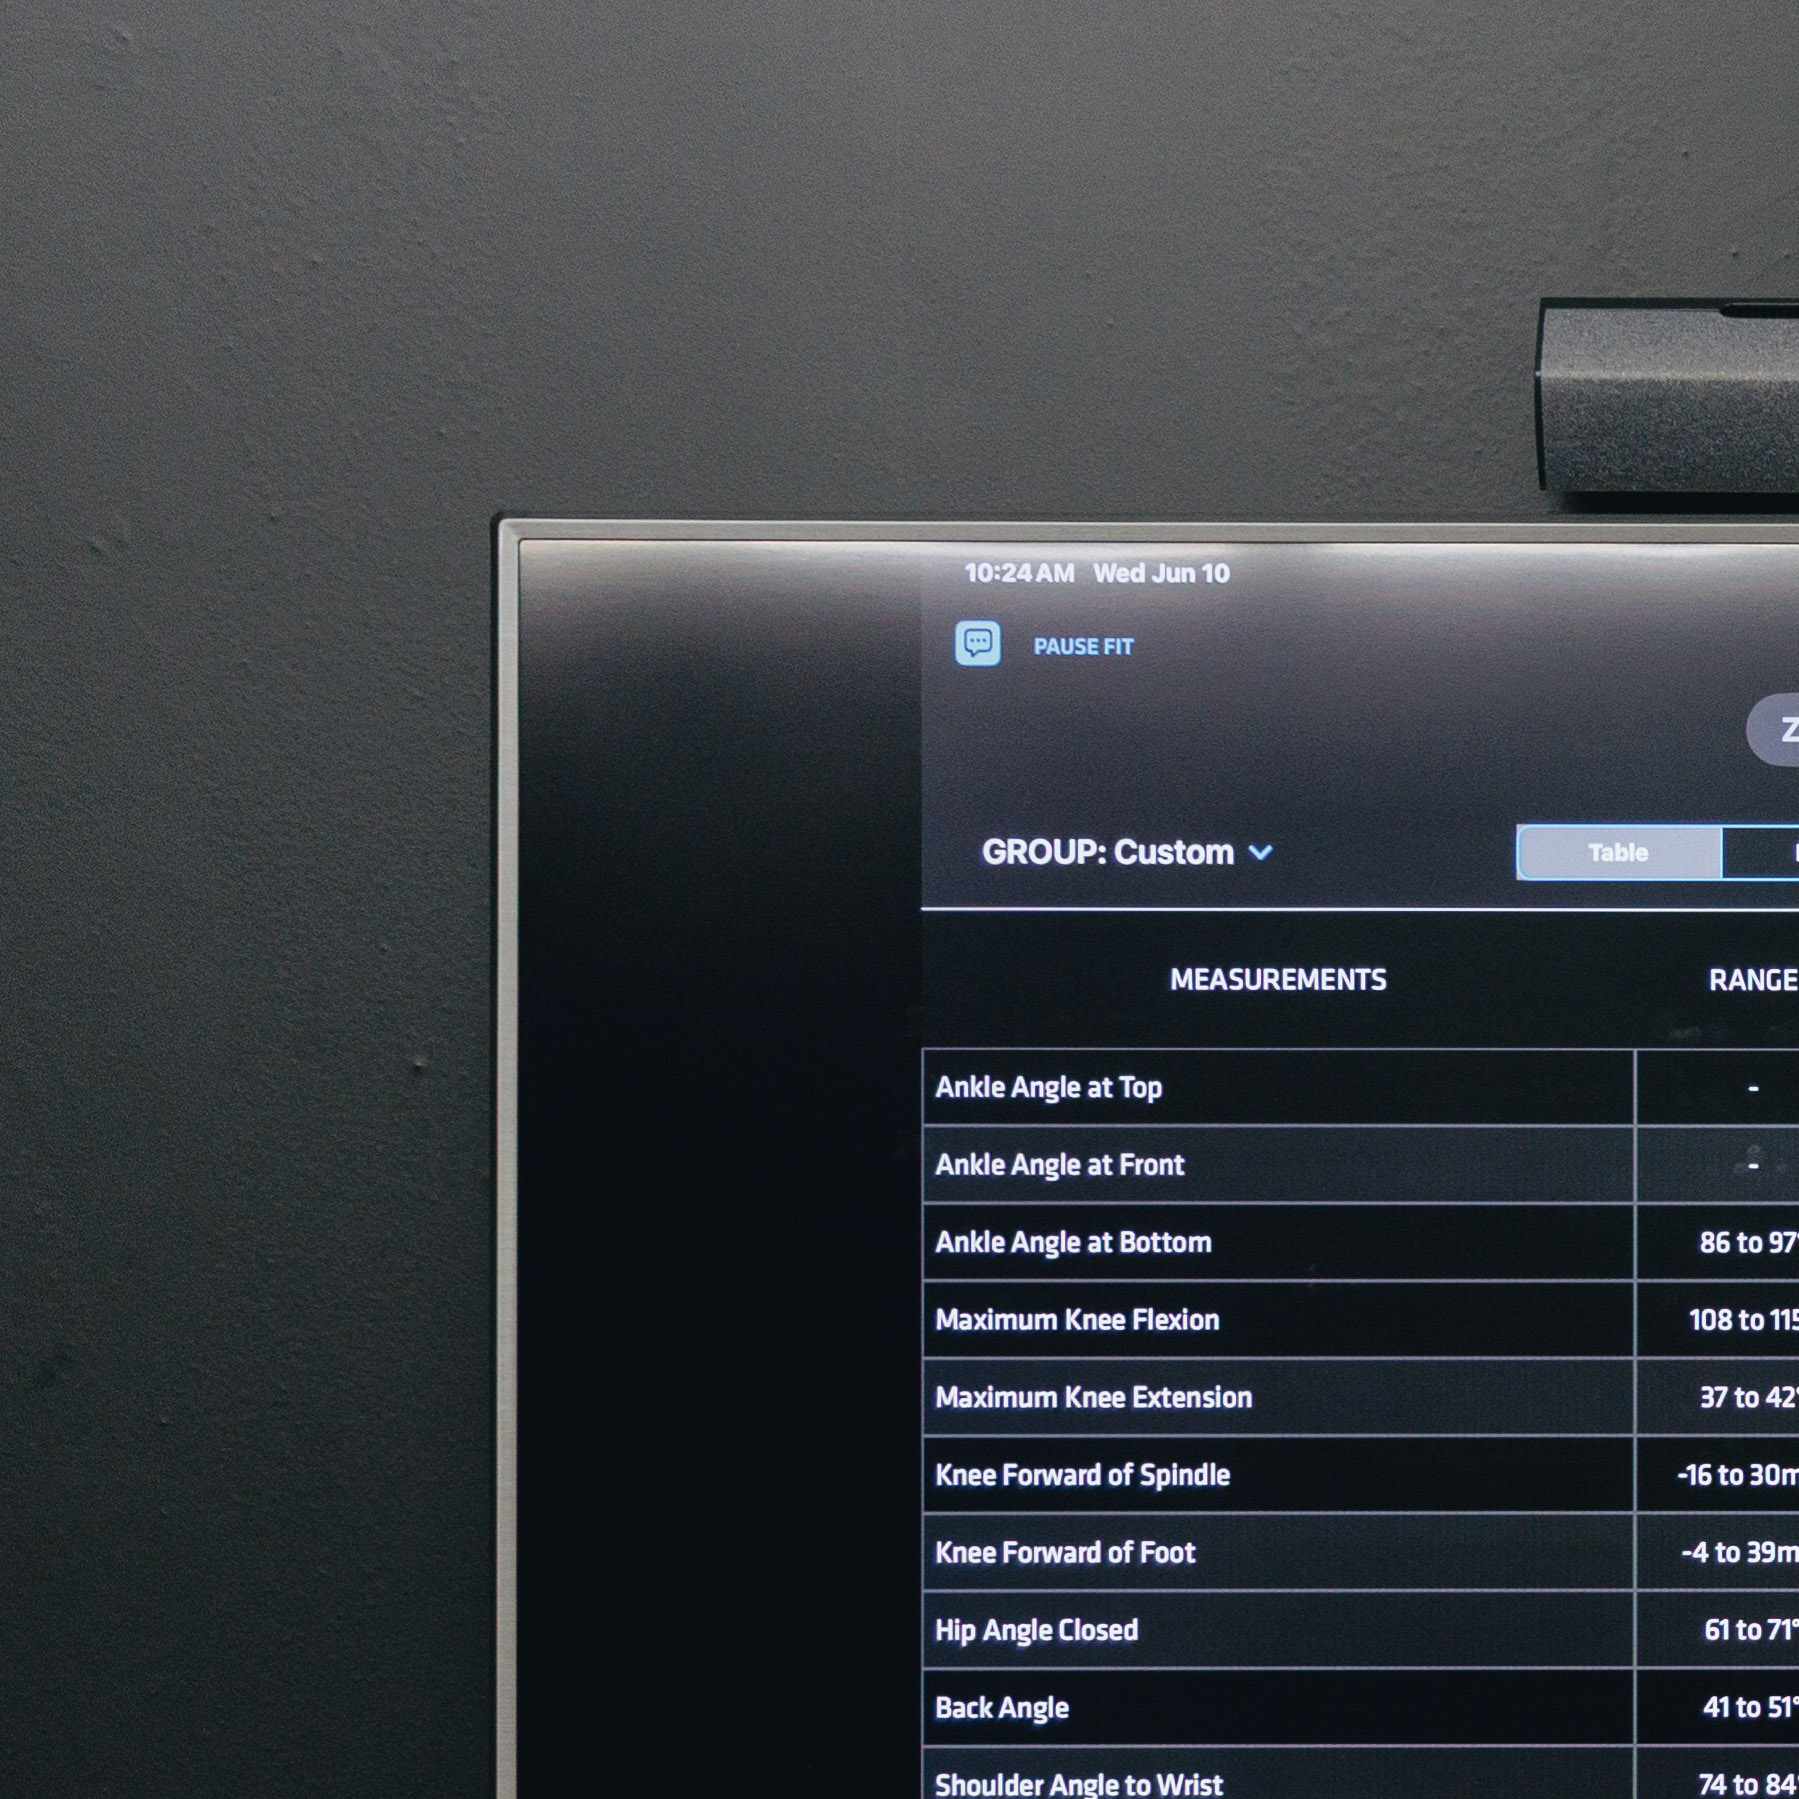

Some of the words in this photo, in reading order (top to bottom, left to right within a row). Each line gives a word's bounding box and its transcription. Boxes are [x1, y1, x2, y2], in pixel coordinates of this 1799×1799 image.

[1093, 562, 1146, 584] Wed
[1151, 562, 1197, 584] Jun
[1201, 562, 1231, 584] 10
[1034, 637, 1099, 656] PAUSE
[1103, 637, 1135, 656] FIT
[982, 837, 1107, 866] GROUP:
[1113, 838, 1235, 866] Custom
[1588, 843, 1650, 862] Table
[1170, 967, 1387, 991] MEASUREMENTS
[1710, 968, 1799, 992] RANGE
[935, 1074, 1006, 1099] Ankle
[1010, 1074, 1082, 1104] Angle
[1087, 1077, 1114, 1099] at
[1118, 1075, 1163, 1104] Top
[936, 1307, 1058, 1331] Maximum
[1065, 1307, 1127, 1331] Knee
[1133, 1307, 1220, 1331] Flexion
[1689, 1308, 1733, 1331] 108
[1738, 1309, 1765, 1331] to
[936, 1463, 997, 1487] Knee
[1002, 1462, 1102, 1487] Forward
[1108, 1461, 1135, 1487] of
[1140, 1462, 1231, 1492] Spindle
[1677, 1463, 1713, 1486] -16
[1717, 1464, 1744, 1486] to
[935, 1772, 1045, 1797] Shoulder
[1124, 1774, 1152, 1797] to
[1156, 1772, 1225, 1797] Wrist
[1699, 1773, 1728, 1796] 74
[1732, 1774, 1759, 1796] to
